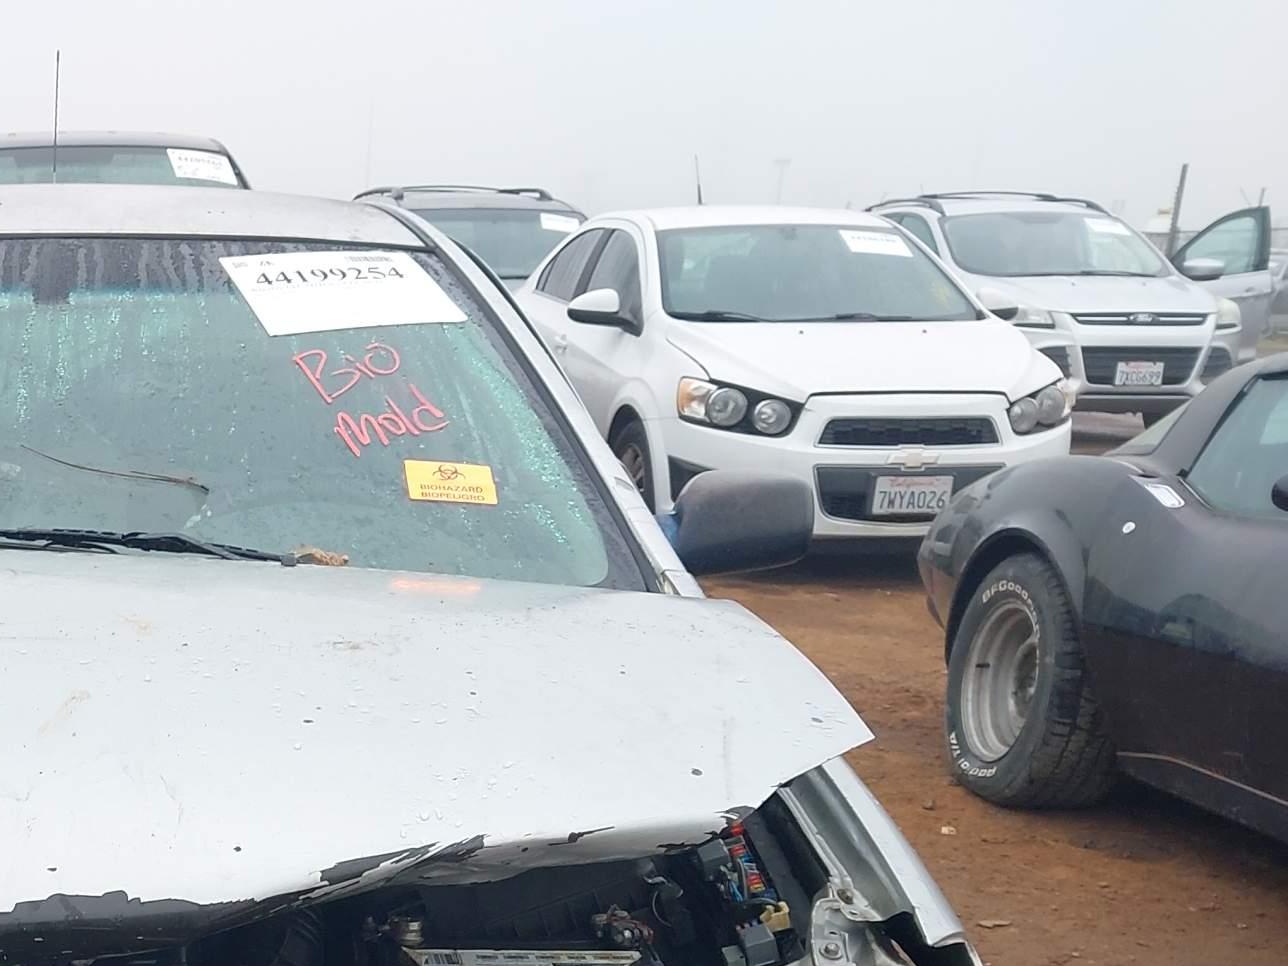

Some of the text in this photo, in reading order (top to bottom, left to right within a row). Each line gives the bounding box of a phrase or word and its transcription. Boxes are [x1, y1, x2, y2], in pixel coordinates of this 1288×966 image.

[257, 266, 404, 285] 44199254
[420, 483, 483, 494] BIOHAZARD
[421, 491, 486, 501] BIOPELIGRO
